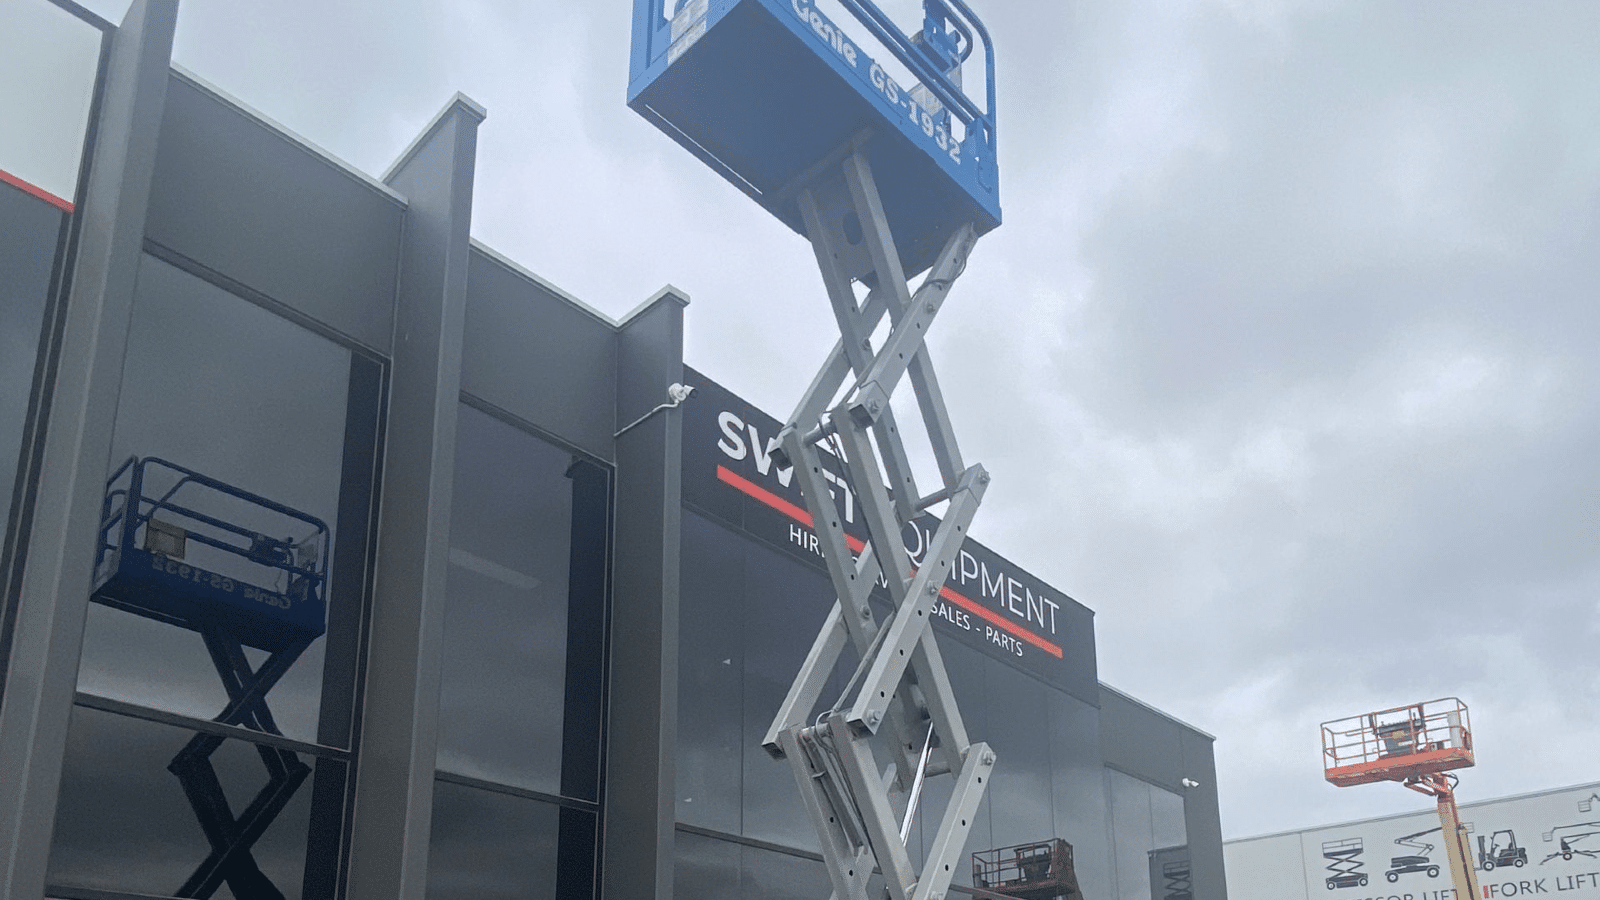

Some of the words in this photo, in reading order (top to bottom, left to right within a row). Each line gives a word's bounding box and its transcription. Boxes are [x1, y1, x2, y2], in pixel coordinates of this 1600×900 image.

[790, 0, 857, 68] Genie
[869, 63, 961, 165] GS-1932
[789, 524, 825, 558] HIR
[985, 626, 1023, 657] PARTS
[1490, 877, 1549, 898] FORK
[1556, 872, 1600, 892] LIFT
